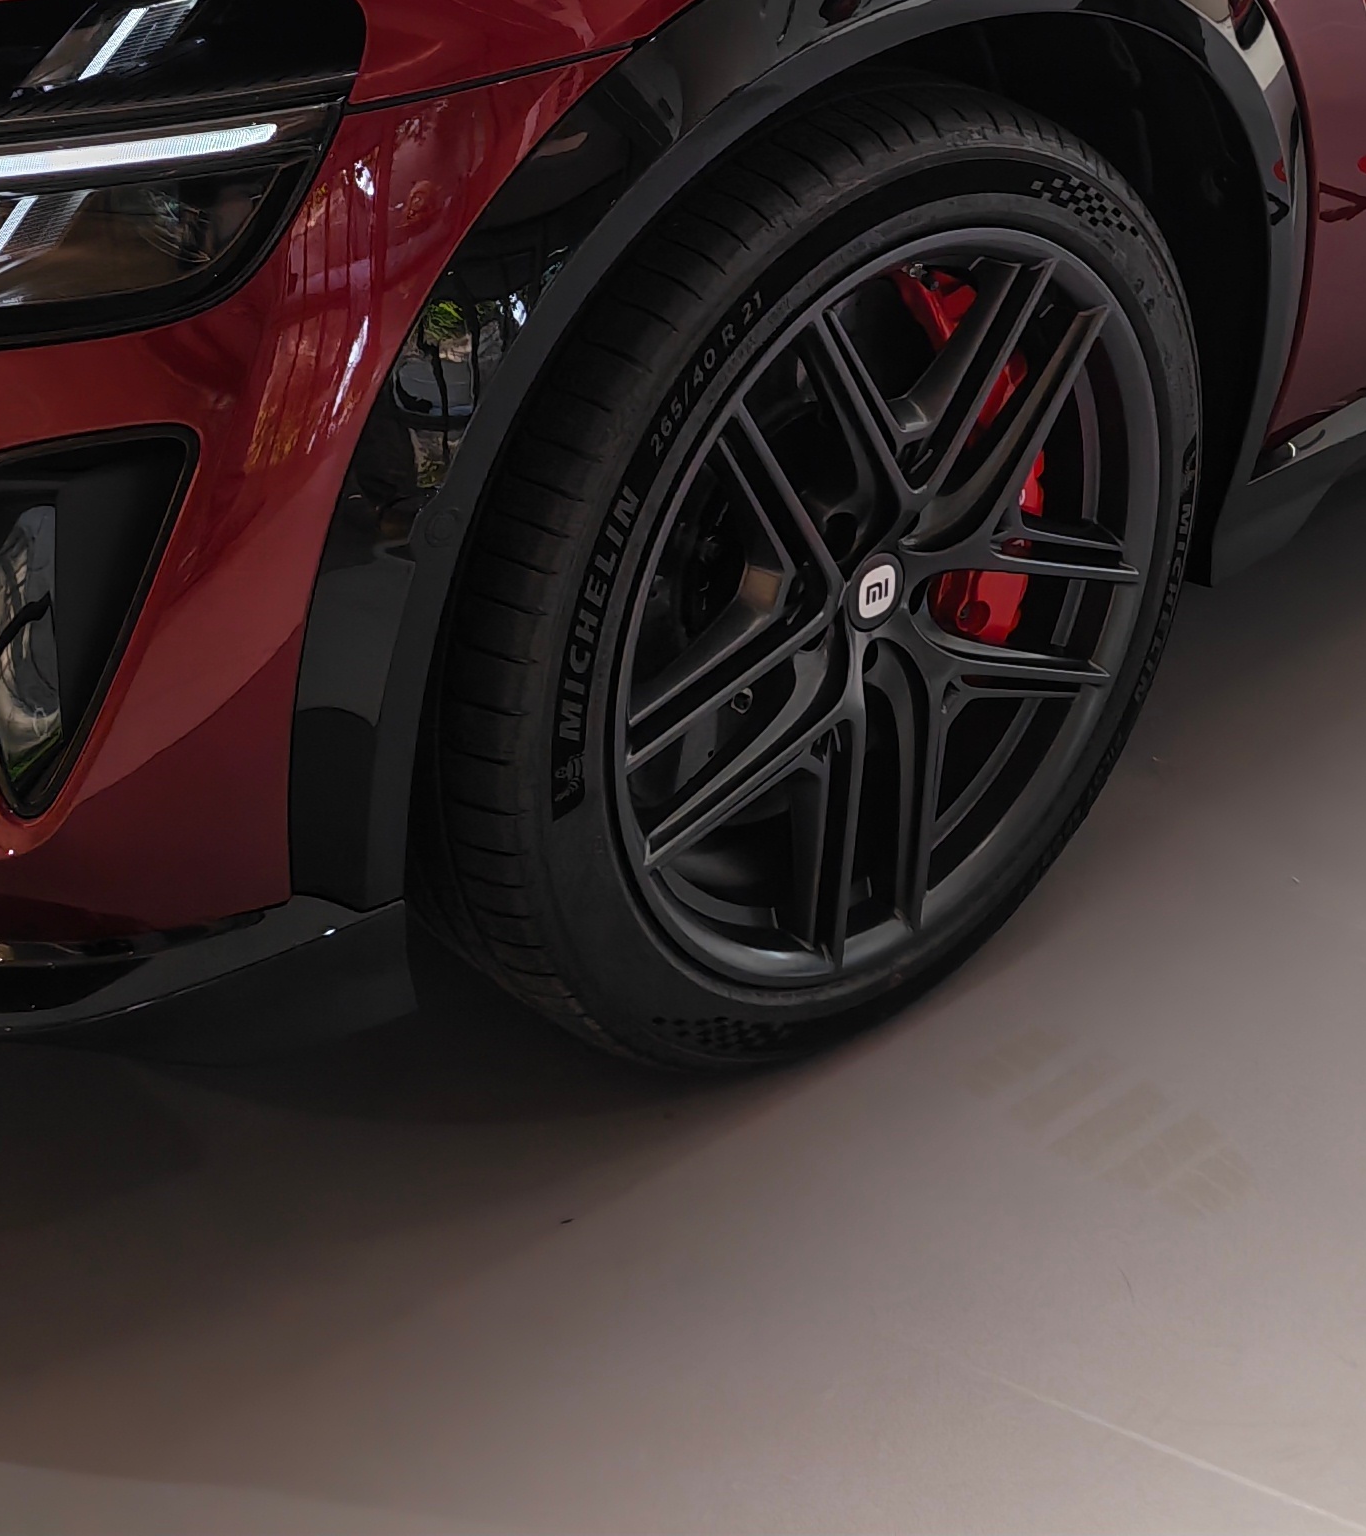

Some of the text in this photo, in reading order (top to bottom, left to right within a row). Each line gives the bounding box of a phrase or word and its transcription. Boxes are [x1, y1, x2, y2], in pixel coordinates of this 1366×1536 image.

[558, 290, 763, 743] MICHELIN 265/40 R 21
